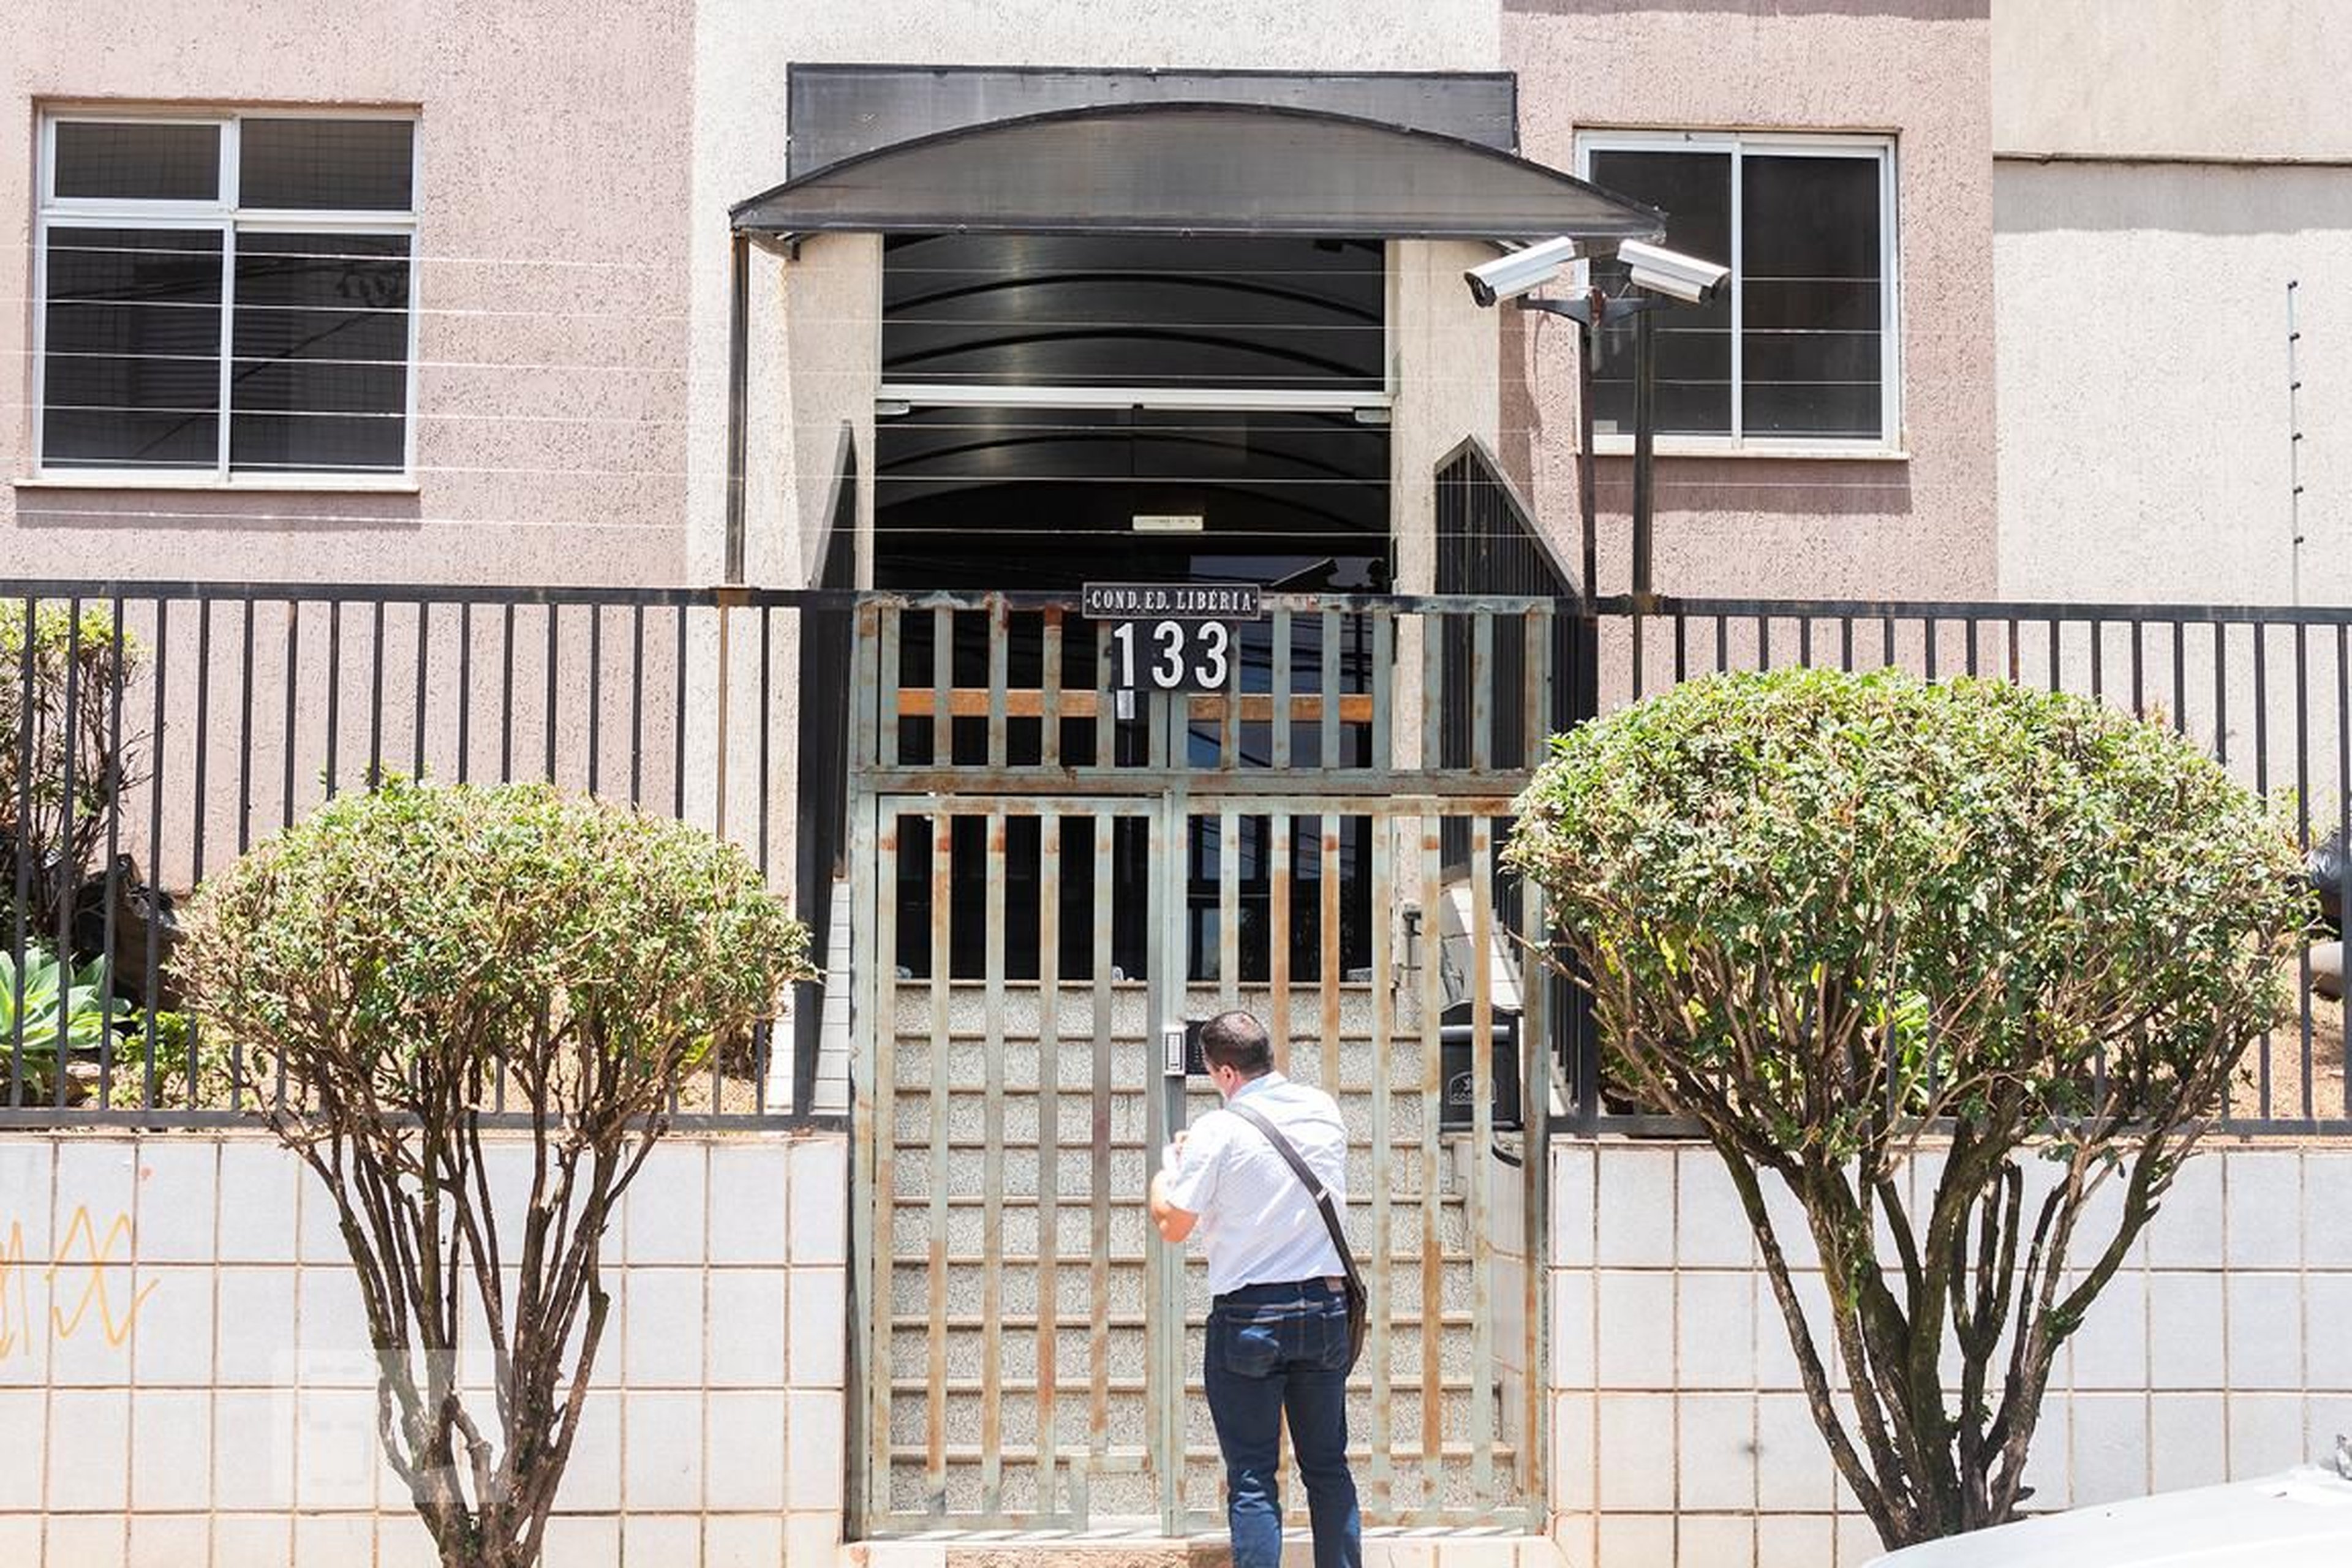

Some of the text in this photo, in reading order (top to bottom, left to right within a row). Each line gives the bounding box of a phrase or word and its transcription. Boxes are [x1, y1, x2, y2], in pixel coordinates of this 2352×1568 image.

[1092, 590, 1140, 609] COND.
[1145, 591, 1169, 609] ED.
[1114, 620, 1227, 688] 133
